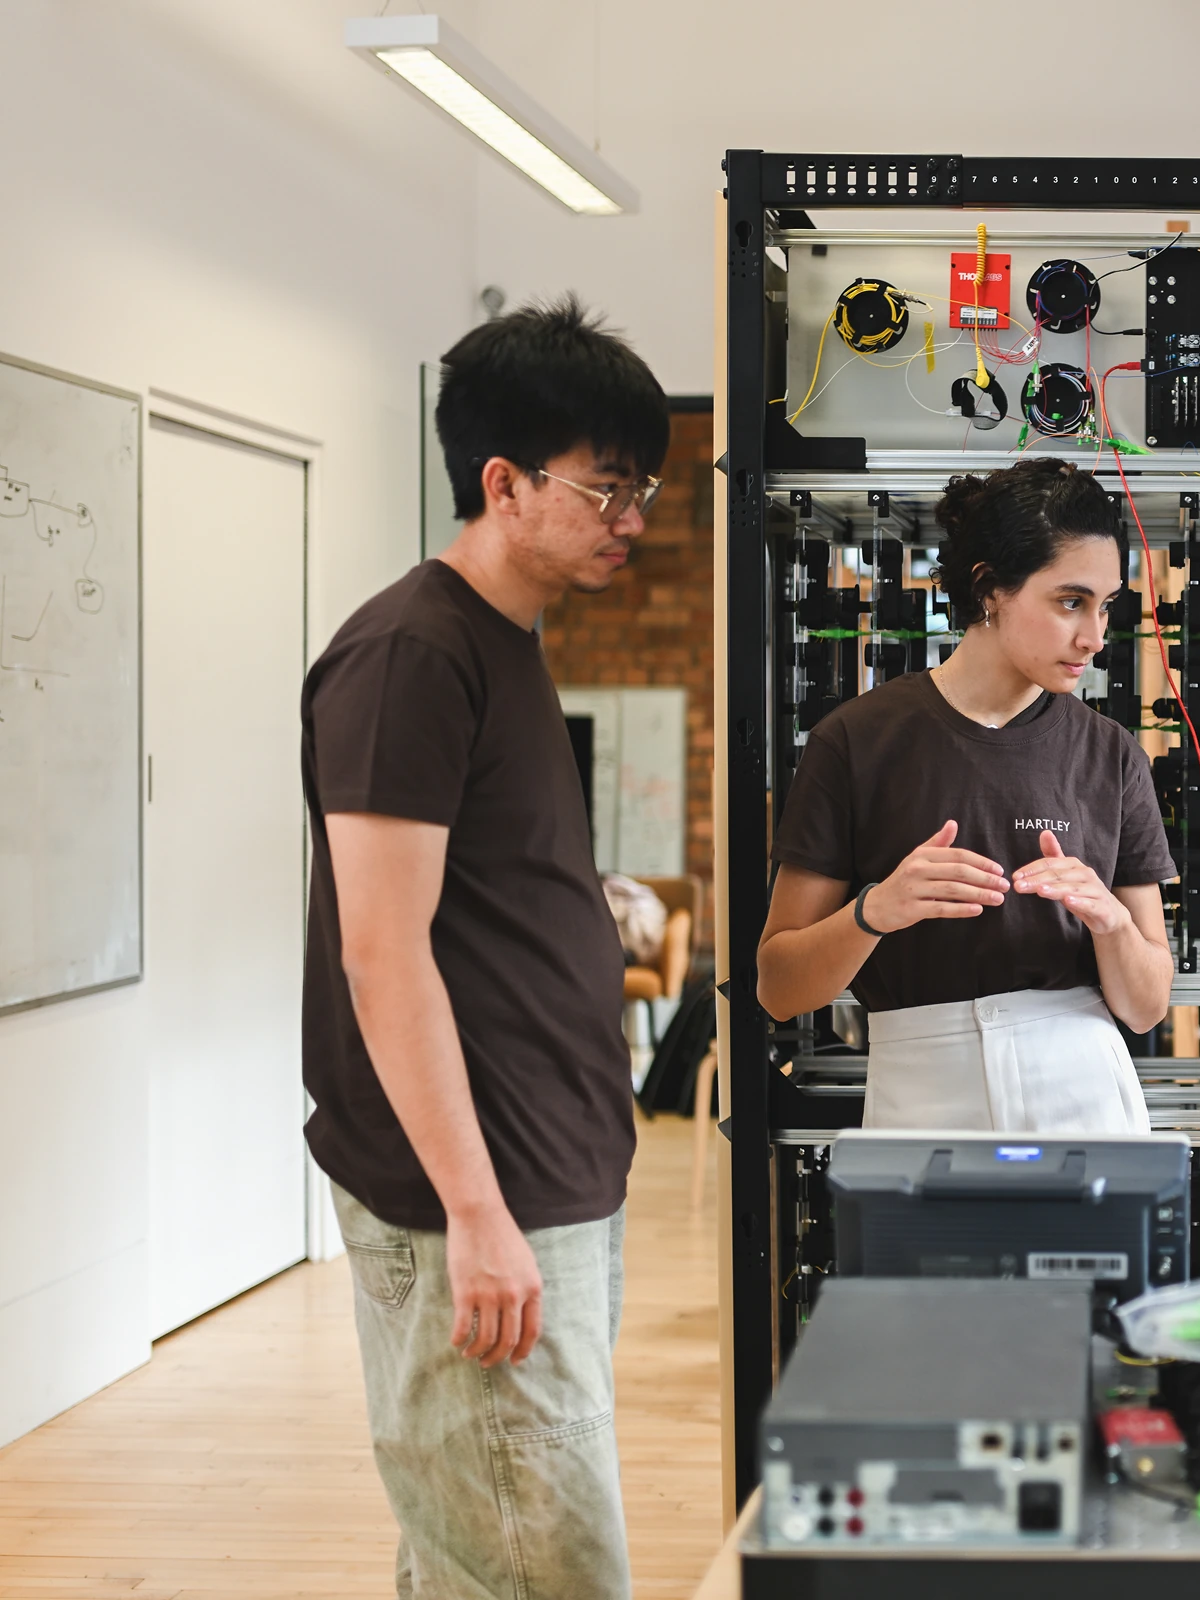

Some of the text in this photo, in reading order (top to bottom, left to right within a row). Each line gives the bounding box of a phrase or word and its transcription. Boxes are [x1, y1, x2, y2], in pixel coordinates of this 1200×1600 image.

[930, 175, 937, 184] 9
[950, 175, 958, 184] 8
[970, 175, 978, 184] 7
[991, 175, 998, 184] 6
[1011, 175, 1019, 184] 5
[1031, 176, 1039, 184] 4
[1052, 175, 1059, 185] 3
[1072, 175, 1079, 184] 2
[1093, 176, 1099, 185] 1
[1113, 176, 1120, 185] 0
[1131, 176, 1138, 185] 0
[1152, 176, 1158, 185] 1
[1172, 176, 1179, 185] 2
[1192, 176, 1199, 185] 3
[957, 272, 1003, 282] THOABS
[1015, 818, 1071, 832] HARTLEY
